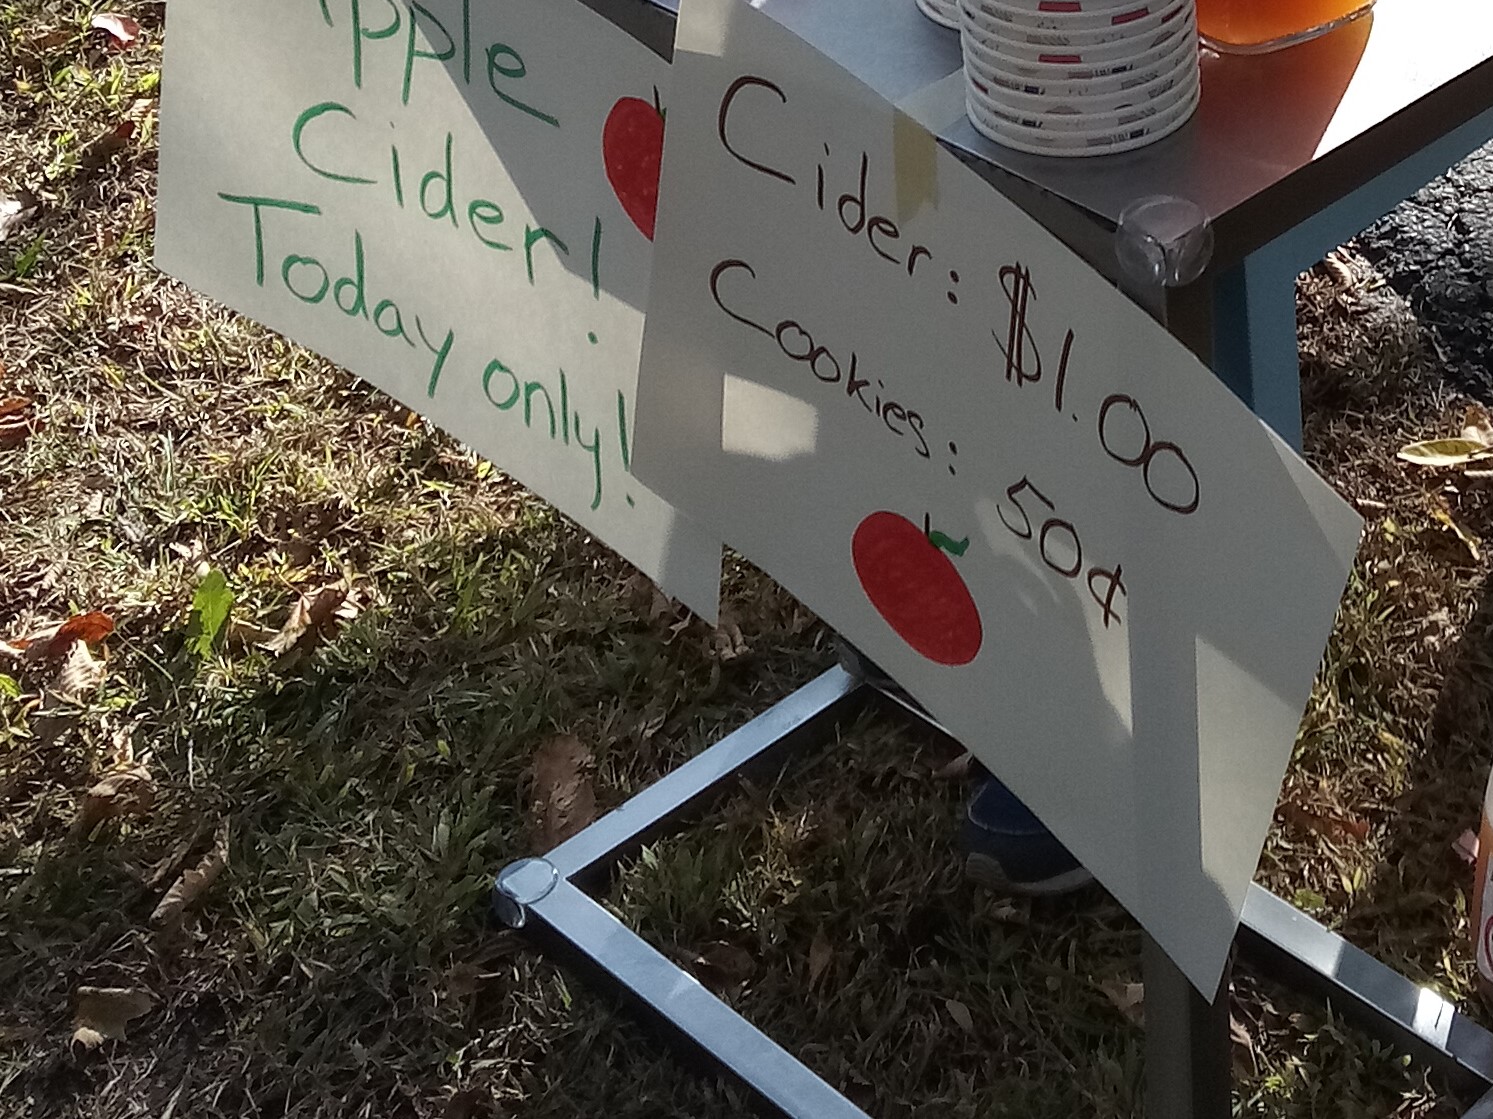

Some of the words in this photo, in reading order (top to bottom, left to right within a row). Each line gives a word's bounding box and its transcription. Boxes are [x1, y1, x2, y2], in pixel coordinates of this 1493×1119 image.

[218, 191, 454, 397] Today
[483, 356, 637, 510] only!
[292, 101, 602, 345] Cider!
[717, 75, 960, 305] Cider:
[992, 262, 1201, 515] $1.00
[709, 258, 958, 476] Cookies:
[995, 476, 1129, 632] 50¢
